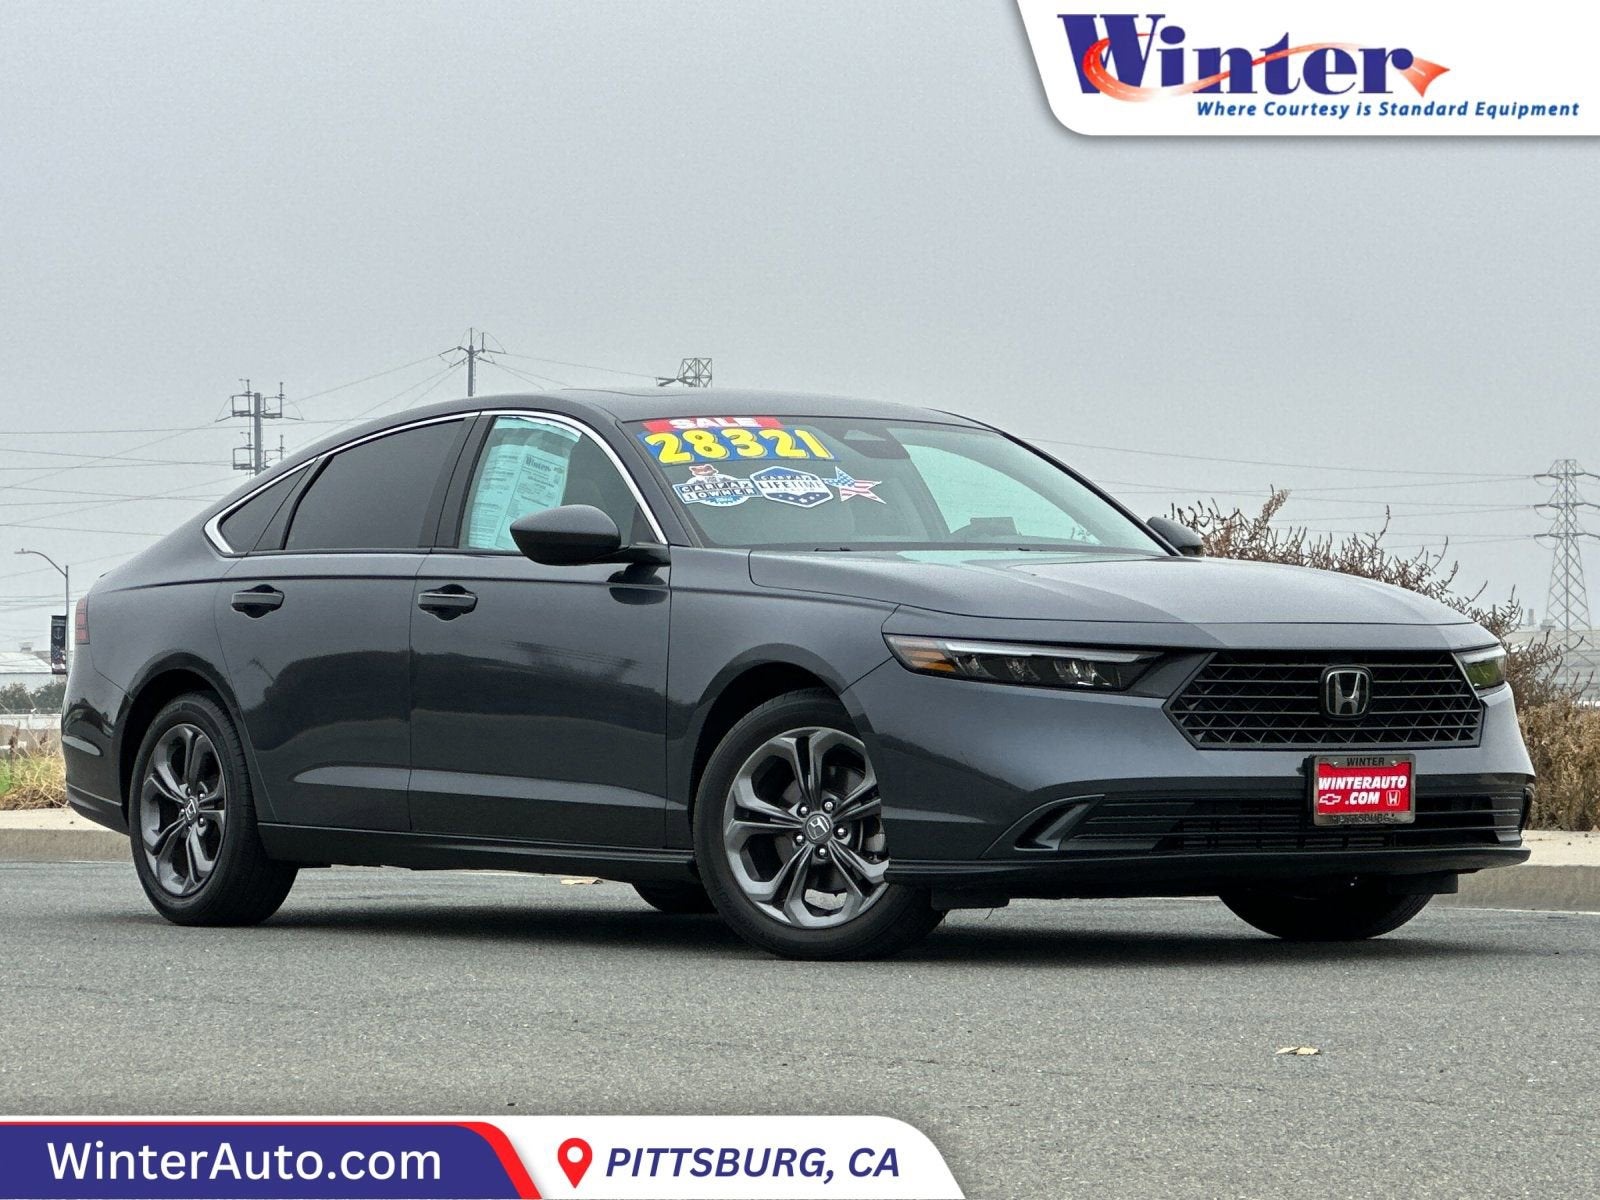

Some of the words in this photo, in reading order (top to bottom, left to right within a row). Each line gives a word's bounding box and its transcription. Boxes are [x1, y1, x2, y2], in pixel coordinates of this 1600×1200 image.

[669, 417, 760, 429] SALE
[644, 428, 835, 464] 28321
[1347, 757, 1385, 766] WINTER
[1318, 776, 1408, 790] WINTERAUTO
[1345, 791, 1381, 805] .COM
